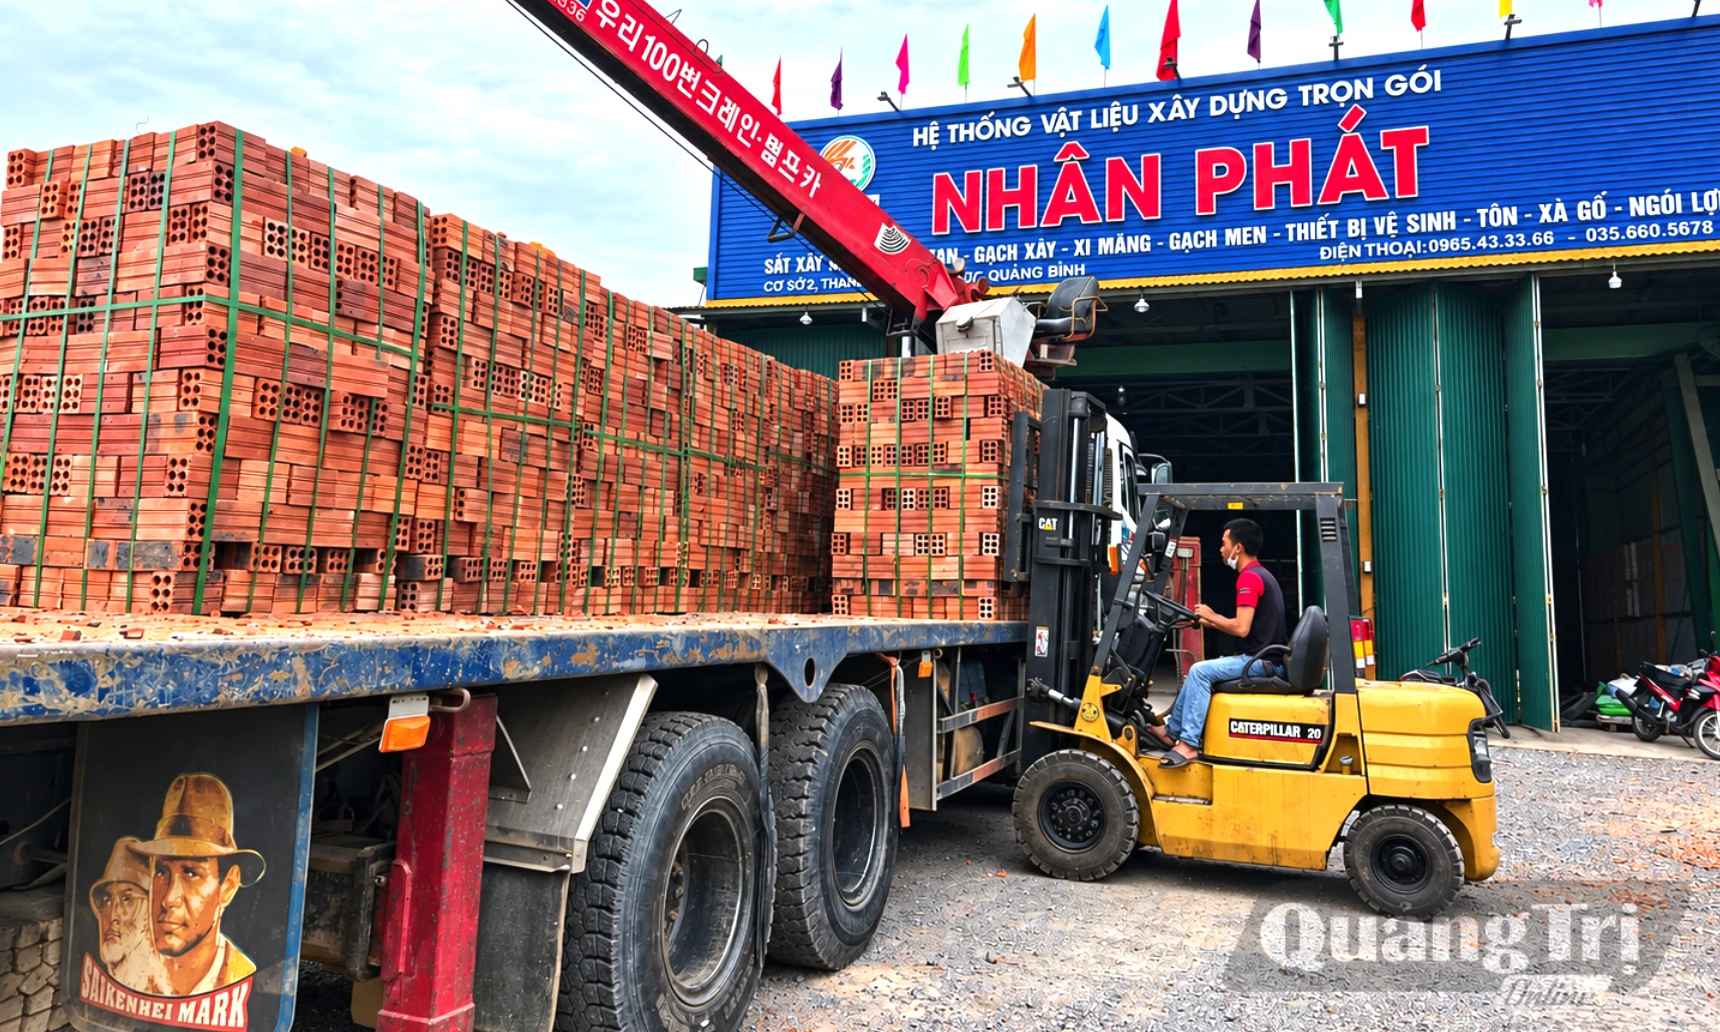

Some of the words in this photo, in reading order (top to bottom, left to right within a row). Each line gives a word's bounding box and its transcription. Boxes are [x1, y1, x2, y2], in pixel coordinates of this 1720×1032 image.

[912, 120, 940, 151] HỆ
[947, 111, 1032, 144] THỐNG
[1041, 106, 1082, 138] VẬT
[1090, 101, 1138, 132] LIỆU
[1147, 94, 1200, 124] XÂY
[1210, 88, 1288, 119] DỰNG
[1298, 77, 1374, 108] TRỌN
[1384, 64, 1441, 97] GÓI
[932, 140, 1162, 236] NHÂN
[1194, 104, 1430, 215] PHÁT
[974, 243, 1018, 266] GẠCH
[1024, 238, 1056, 260] XÂY
[1073, 238, 1091, 257] XI
[1098, 233, 1151, 255] MĂNG
[1169, 230, 1217, 253] GẠCH
[1225, 226, 1267, 246] MEN
[1285, 213, 1339, 241] THIẾT
[1347, 218, 1367, 240] BỊ
[1374, 211, 1398, 238] VỆ
[1406, 211, 1456, 233] SINH
[1477, 202, 1518, 228] TÔN
[1538, 198, 1569, 223] XÀ
[1577, 190, 1608, 221] GỐ
[1629, 188, 1683, 217] NGÓI
[1691, 188, 1720, 216] LỢ
[1320, 241, 1362, 262] ĐIỆN
[1586, 220, 1714, 242] 035.660.5678
[764, 252, 791, 275] SẮT
[795, 253, 824, 273] XÂY
[988, 263, 1043, 282] QUẢNG
[1048, 261, 1086, 278] BÌNH
[763, 279, 785, 292] CƠ
[1038, 517, 1058, 531] CAT
[1230, 720, 1301, 739] CATERPILLAR
[1307, 728, 1322, 739] 20
[81, 955, 173, 1021] SAIKENHEI
[177, 982, 249, 1028] MARK
